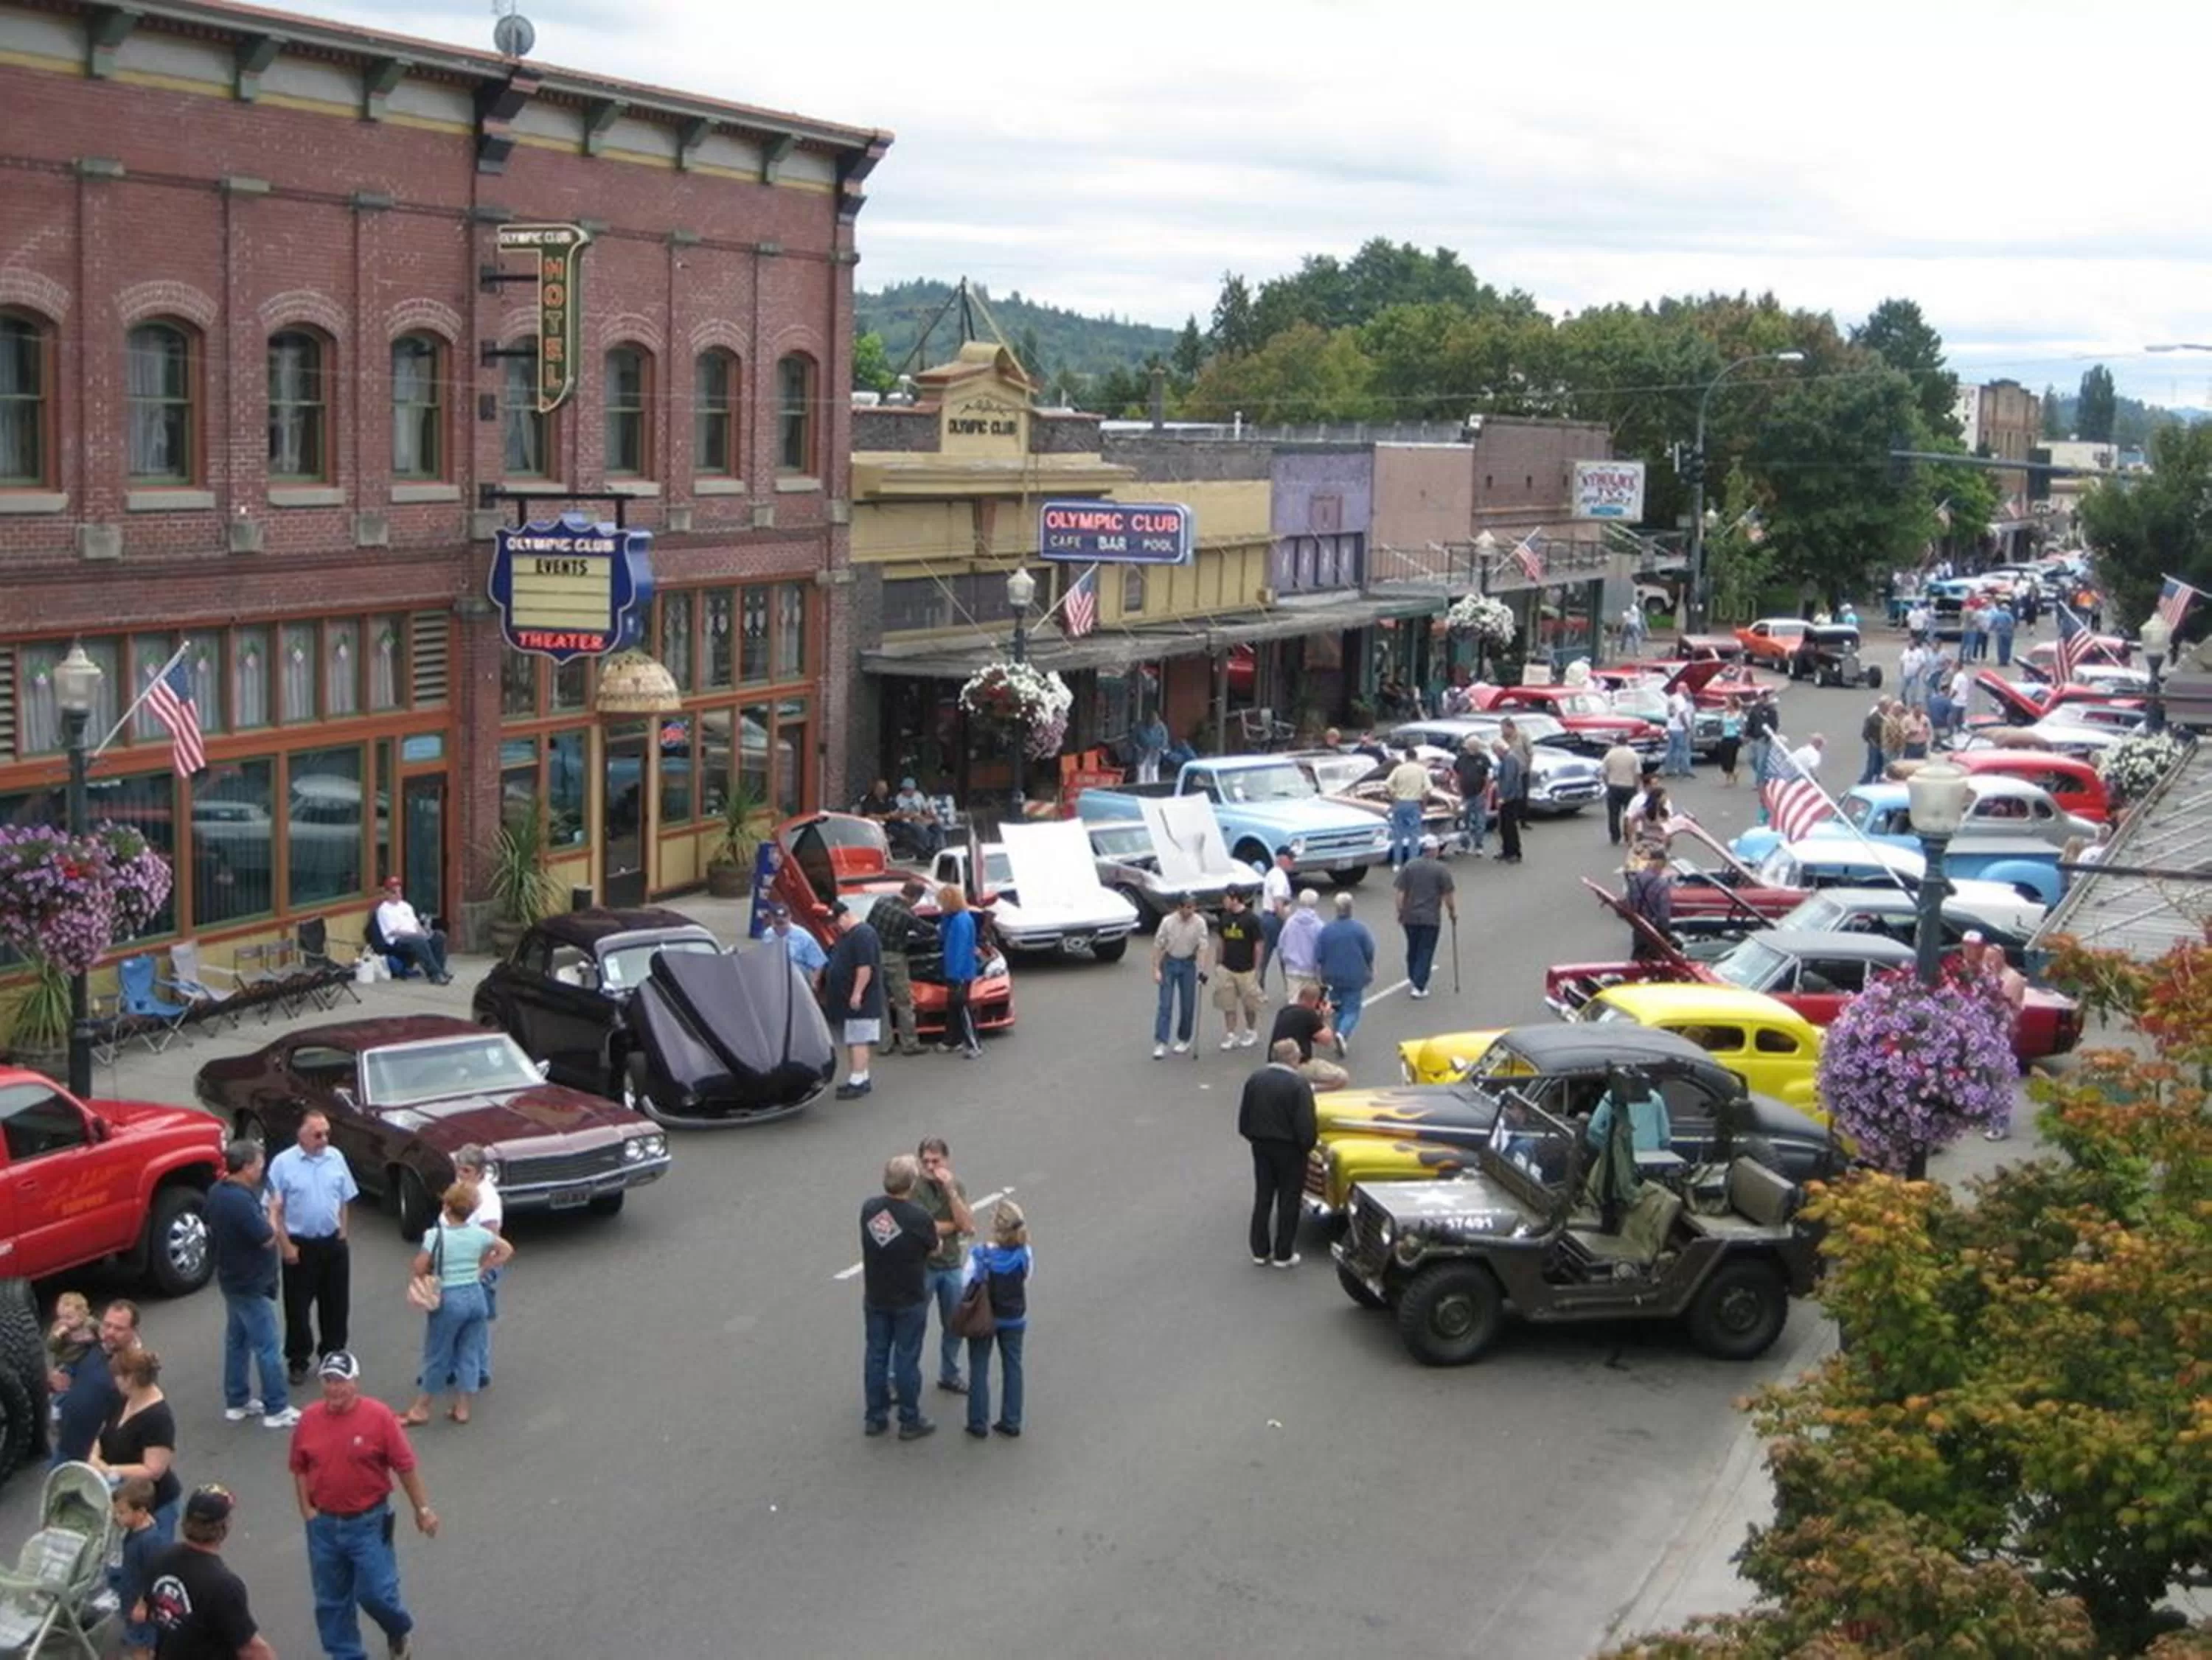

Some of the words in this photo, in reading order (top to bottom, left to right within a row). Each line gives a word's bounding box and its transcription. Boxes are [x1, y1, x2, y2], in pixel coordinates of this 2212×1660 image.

[543, 257, 566, 388] HOTEL
[947, 418, 987, 436] OLYMPIC
[1046, 511, 1124, 531] OLYMPIC
[1130, 513, 1180, 533] CLUB
[507, 537, 571, 551] OLYMPIC
[574, 539, 615, 552] CLUB
[1049, 535, 1082, 548] CAFE
[1096, 535, 1127, 551] BAR
[1143, 539, 1175, 552] POOL
[536, 559, 588, 576] EVENTS
[520, 632, 603, 649] THEATER
